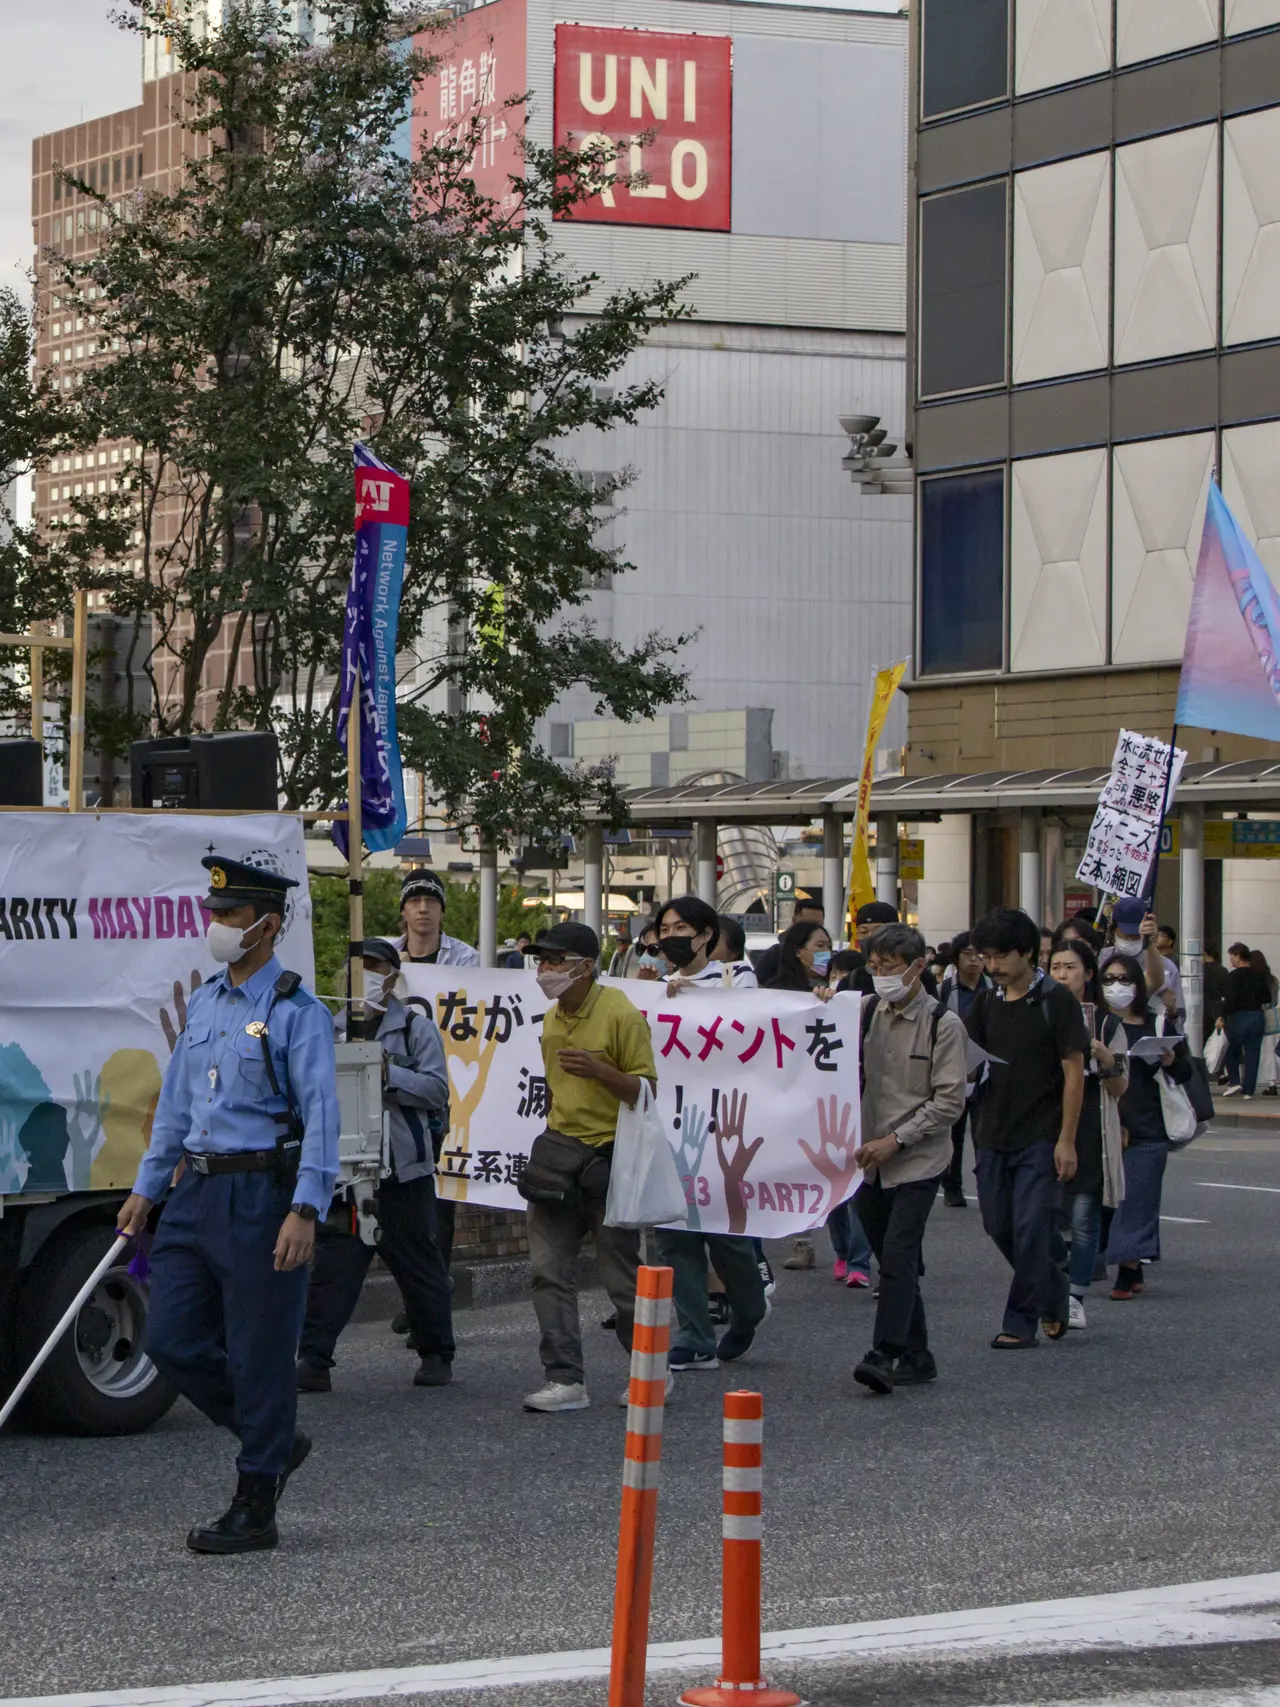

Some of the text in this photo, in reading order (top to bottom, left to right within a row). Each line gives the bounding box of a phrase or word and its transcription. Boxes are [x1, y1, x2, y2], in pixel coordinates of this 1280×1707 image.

[439, 51, 497, 121] 龍角散
[579, 52, 697, 122] UNI
[578, 132, 707, 208] QLO
[374, 538, 398, 614] Network
[640, 1010, 845, 1072] スメントを
[434, 1146, 529, 1186] 立系連
[738, 1180, 824, 1214] PART2
